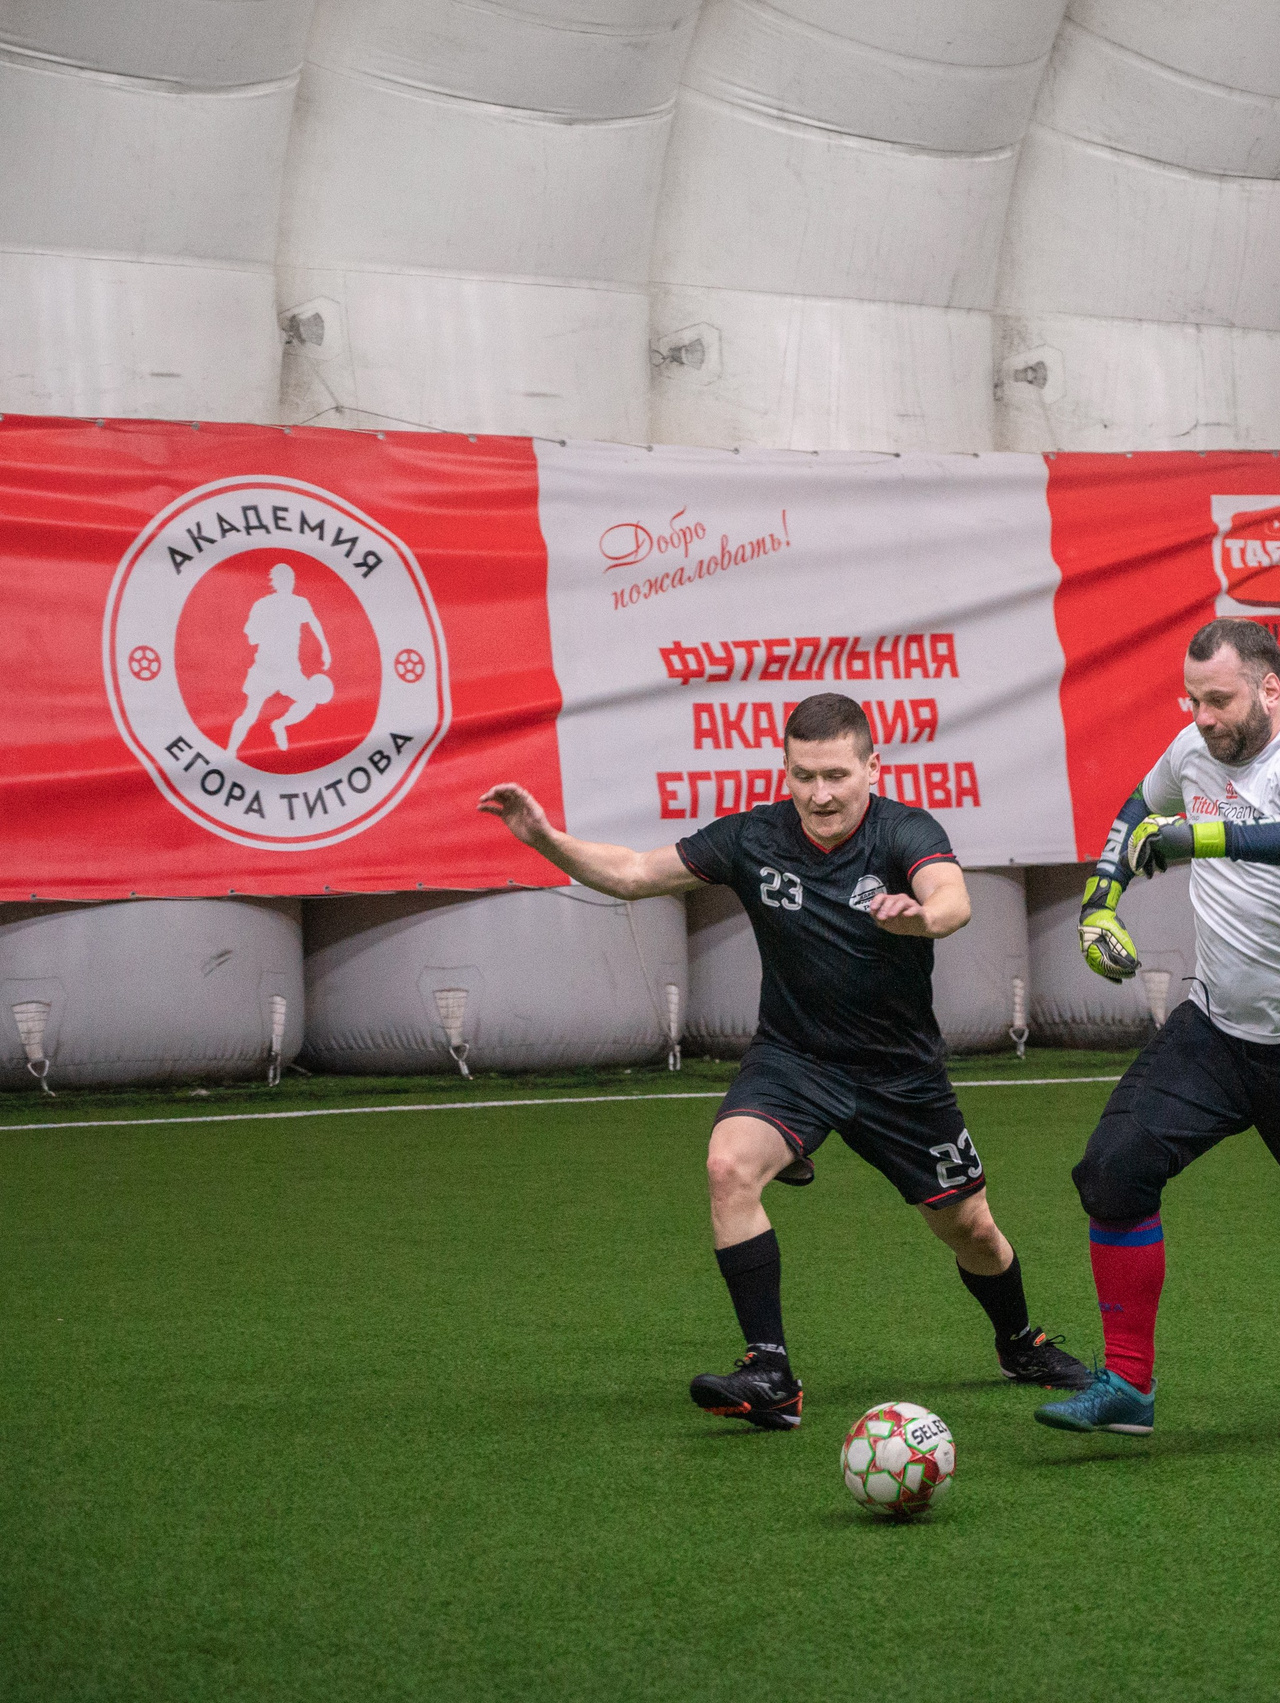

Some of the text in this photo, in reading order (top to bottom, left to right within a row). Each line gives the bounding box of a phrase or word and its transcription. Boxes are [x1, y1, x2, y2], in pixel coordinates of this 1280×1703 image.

[167, 505, 384, 580] АКАДЕМИЯ
[599, 505, 707, 575] Добро
[611, 508, 792, 611] пожаловать!
[658, 632, 960, 686] ФУТБОЛЬНАЯ
[692, 697, 939, 750] АКАИЯ
[164, 730, 415, 822] ЕГОРА ТИТОВА
[876, 761, 981, 810] ТОВА
[759, 865, 804, 911] 23
[928, 1127, 983, 1189] 23
[910, 1419, 948, 1446] SELEC
